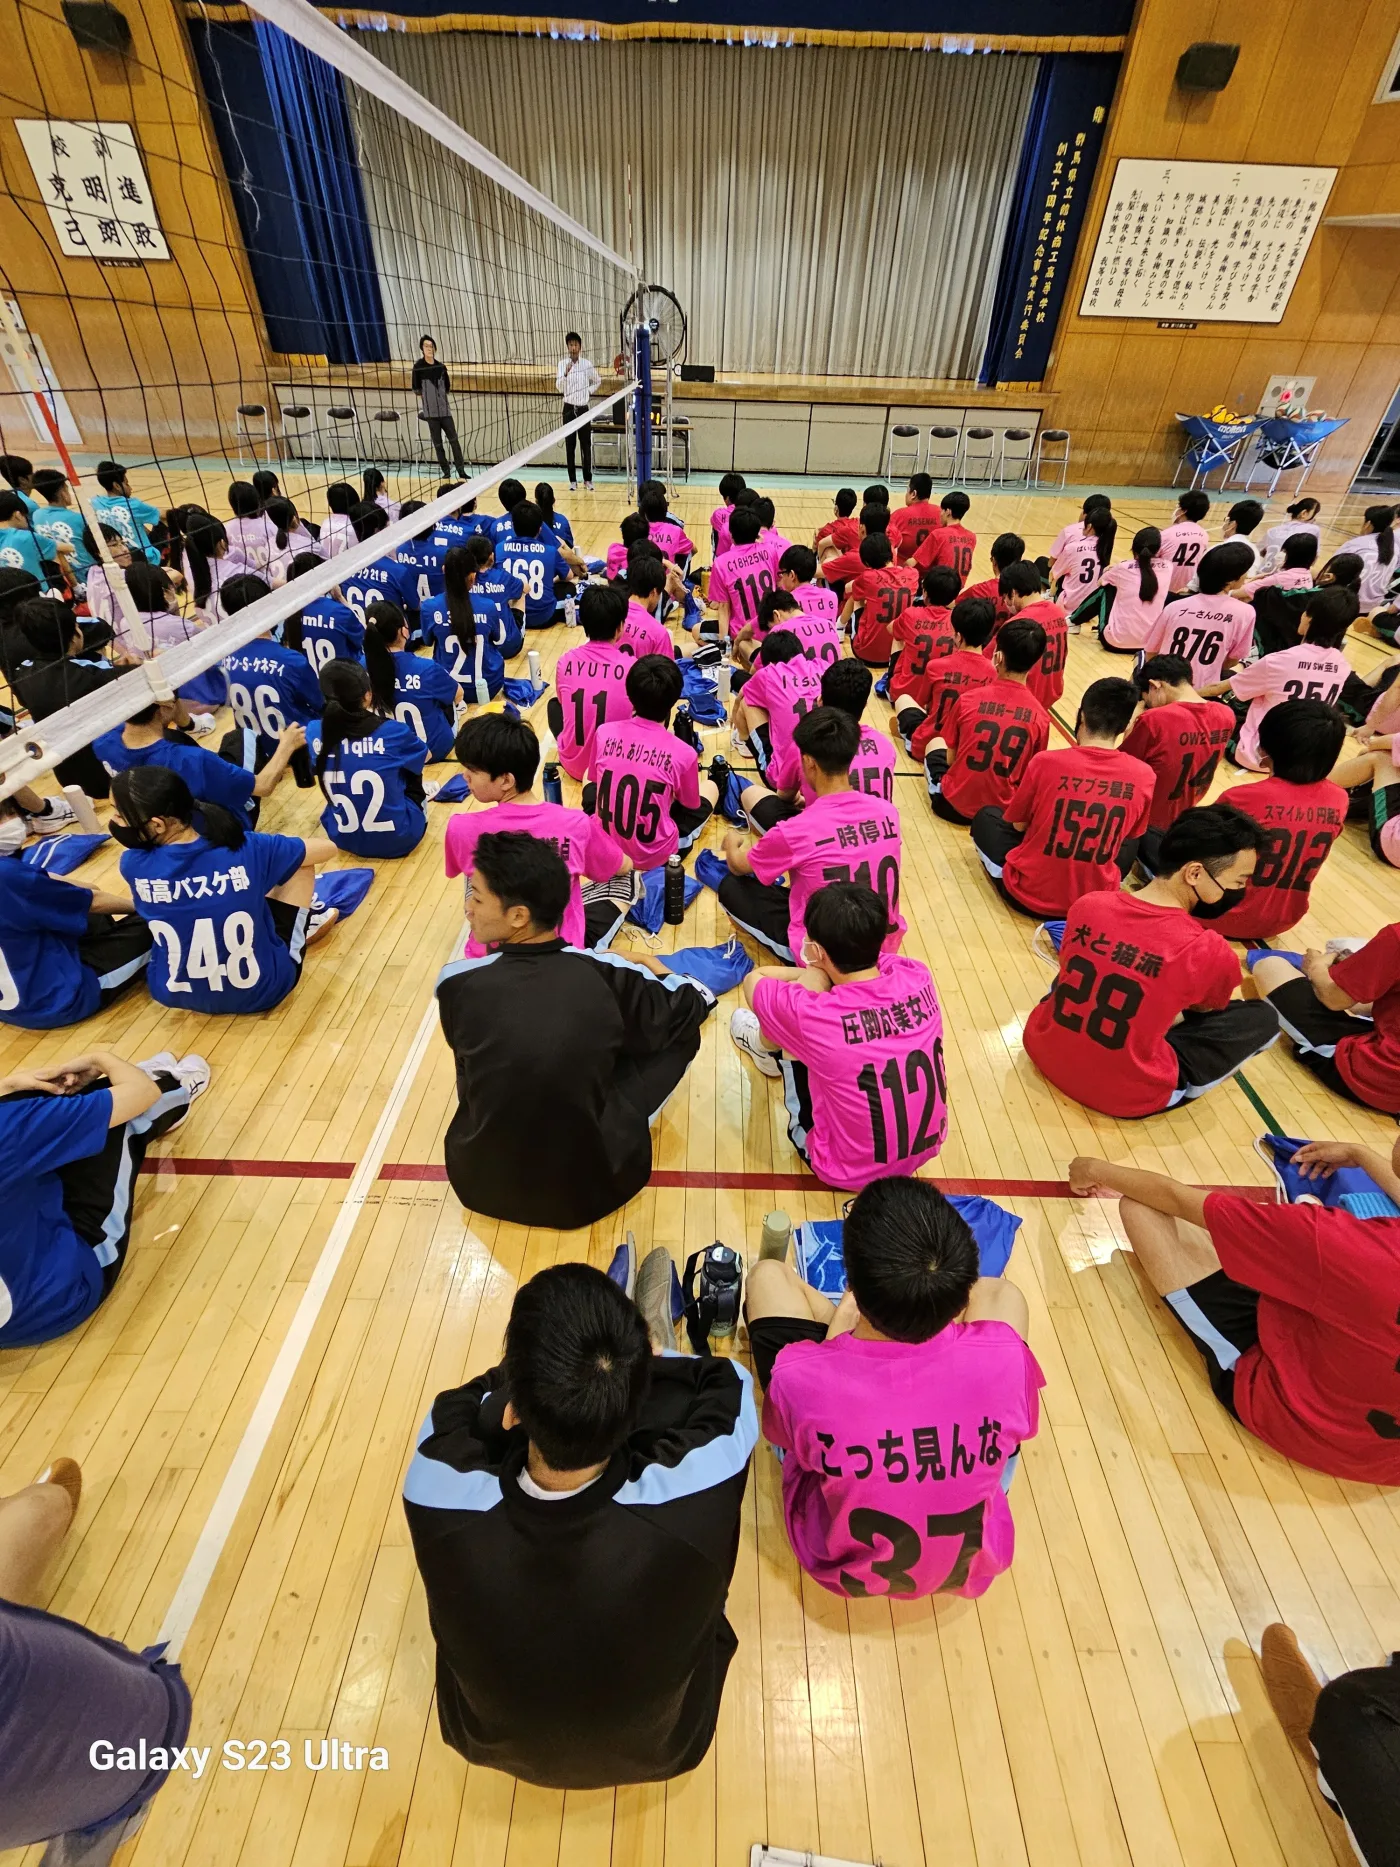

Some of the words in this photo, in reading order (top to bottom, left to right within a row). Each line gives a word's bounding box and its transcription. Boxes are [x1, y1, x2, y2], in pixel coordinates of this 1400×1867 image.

[1014, 142, 1068, 359] 創立十周年記念事業実行委員会
[1035, 132, 1087, 323] 群馬県立館林商工高等学校
[504, 543, 521, 552] VALO
[523, 544, 528, 552] is
[530, 544, 545, 553] GOD
[907, 517, 937, 526] ARSENAL
[953, 546, 973, 576] 10
[1172, 543, 1200, 566] 42
[876, 587, 912, 624] 30
[445, 634, 484, 683] 21
[564, 661, 625, 680] AYUTO
[1169, 626, 1224, 666] 876
[229, 682, 286, 739] 86
[571, 687, 608, 747] 11
[966, 720, 1029, 778] 39
[323, 769, 395, 833] 52
[597, 768, 667, 844] 405
[1057, 776, 1135, 800] スマブラ最高
[815, 815, 898, 849] 一時停止
[1043, 798, 1126, 865] 1520
[1251, 827, 1333, 892] 812
[148, 910, 260, 993] 248
[1071, 923, 1165, 980] 犬と猫派
[1053, 954, 1145, 1050] 28
[816, 1416, 1003, 1484] こっち見んな
[839, 1498, 988, 1598] 37
